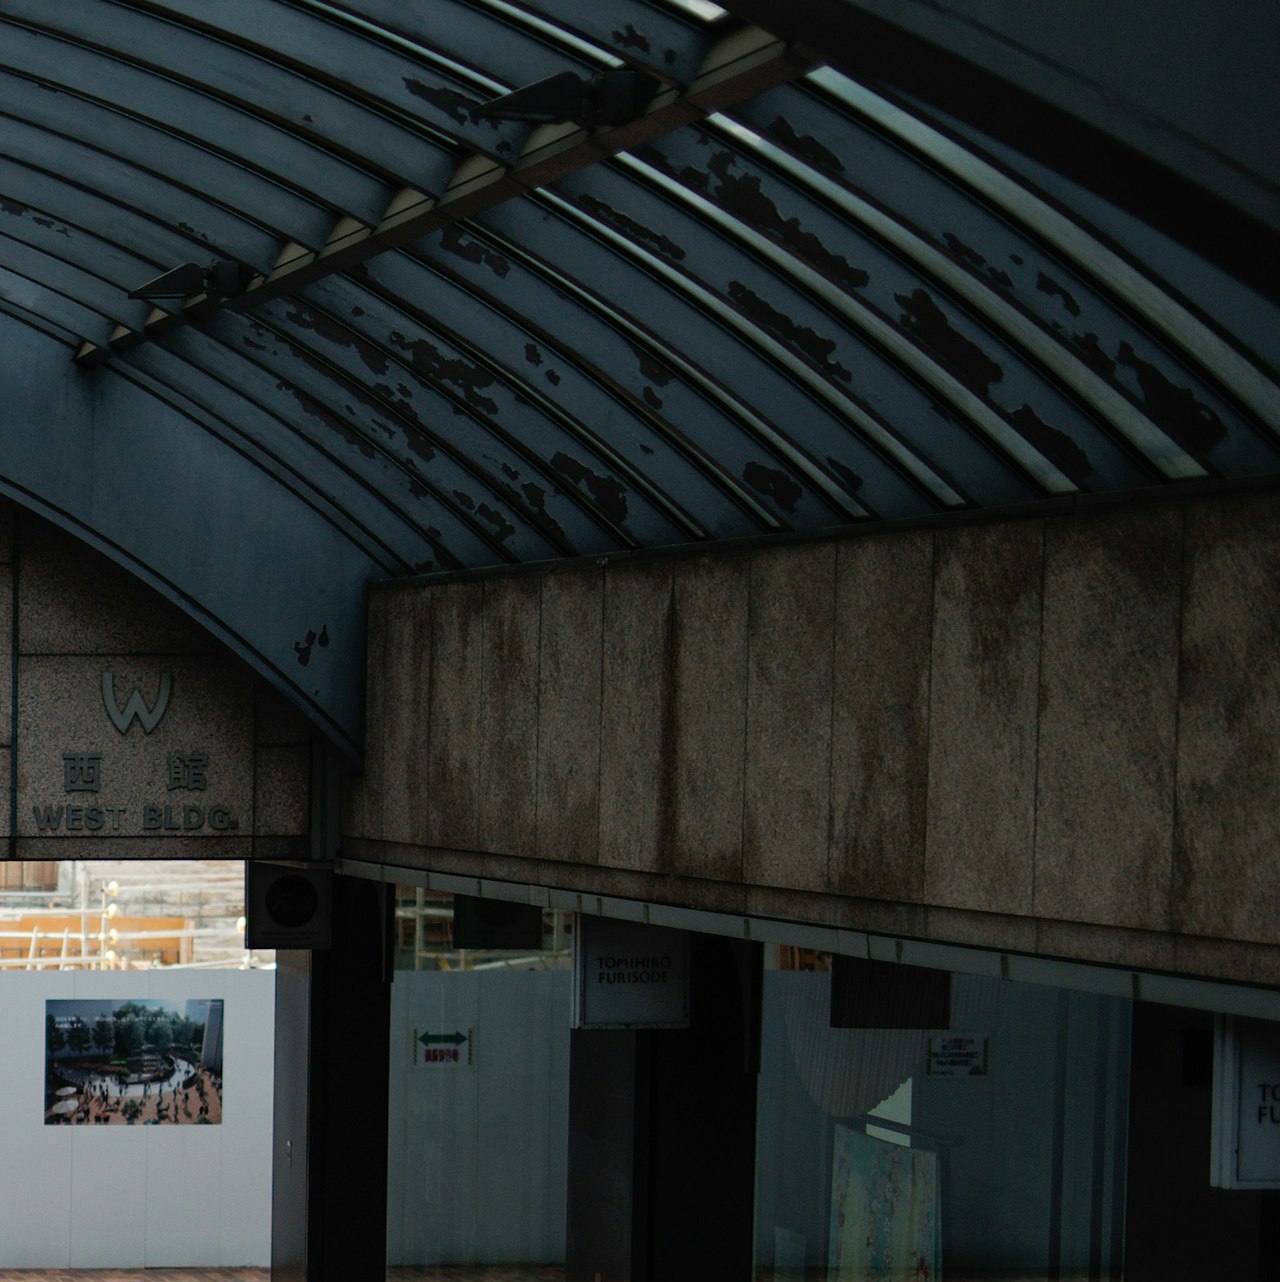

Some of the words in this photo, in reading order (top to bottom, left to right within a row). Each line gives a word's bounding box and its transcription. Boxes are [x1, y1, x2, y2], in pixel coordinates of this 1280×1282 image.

[101, 671, 172, 736] W
[33, 805, 127, 831] WEST
[143, 804, 238, 831] BLDG.
[597, 956, 672, 969] TOMIHIRO
[599, 971, 669, 984] FURISODE
